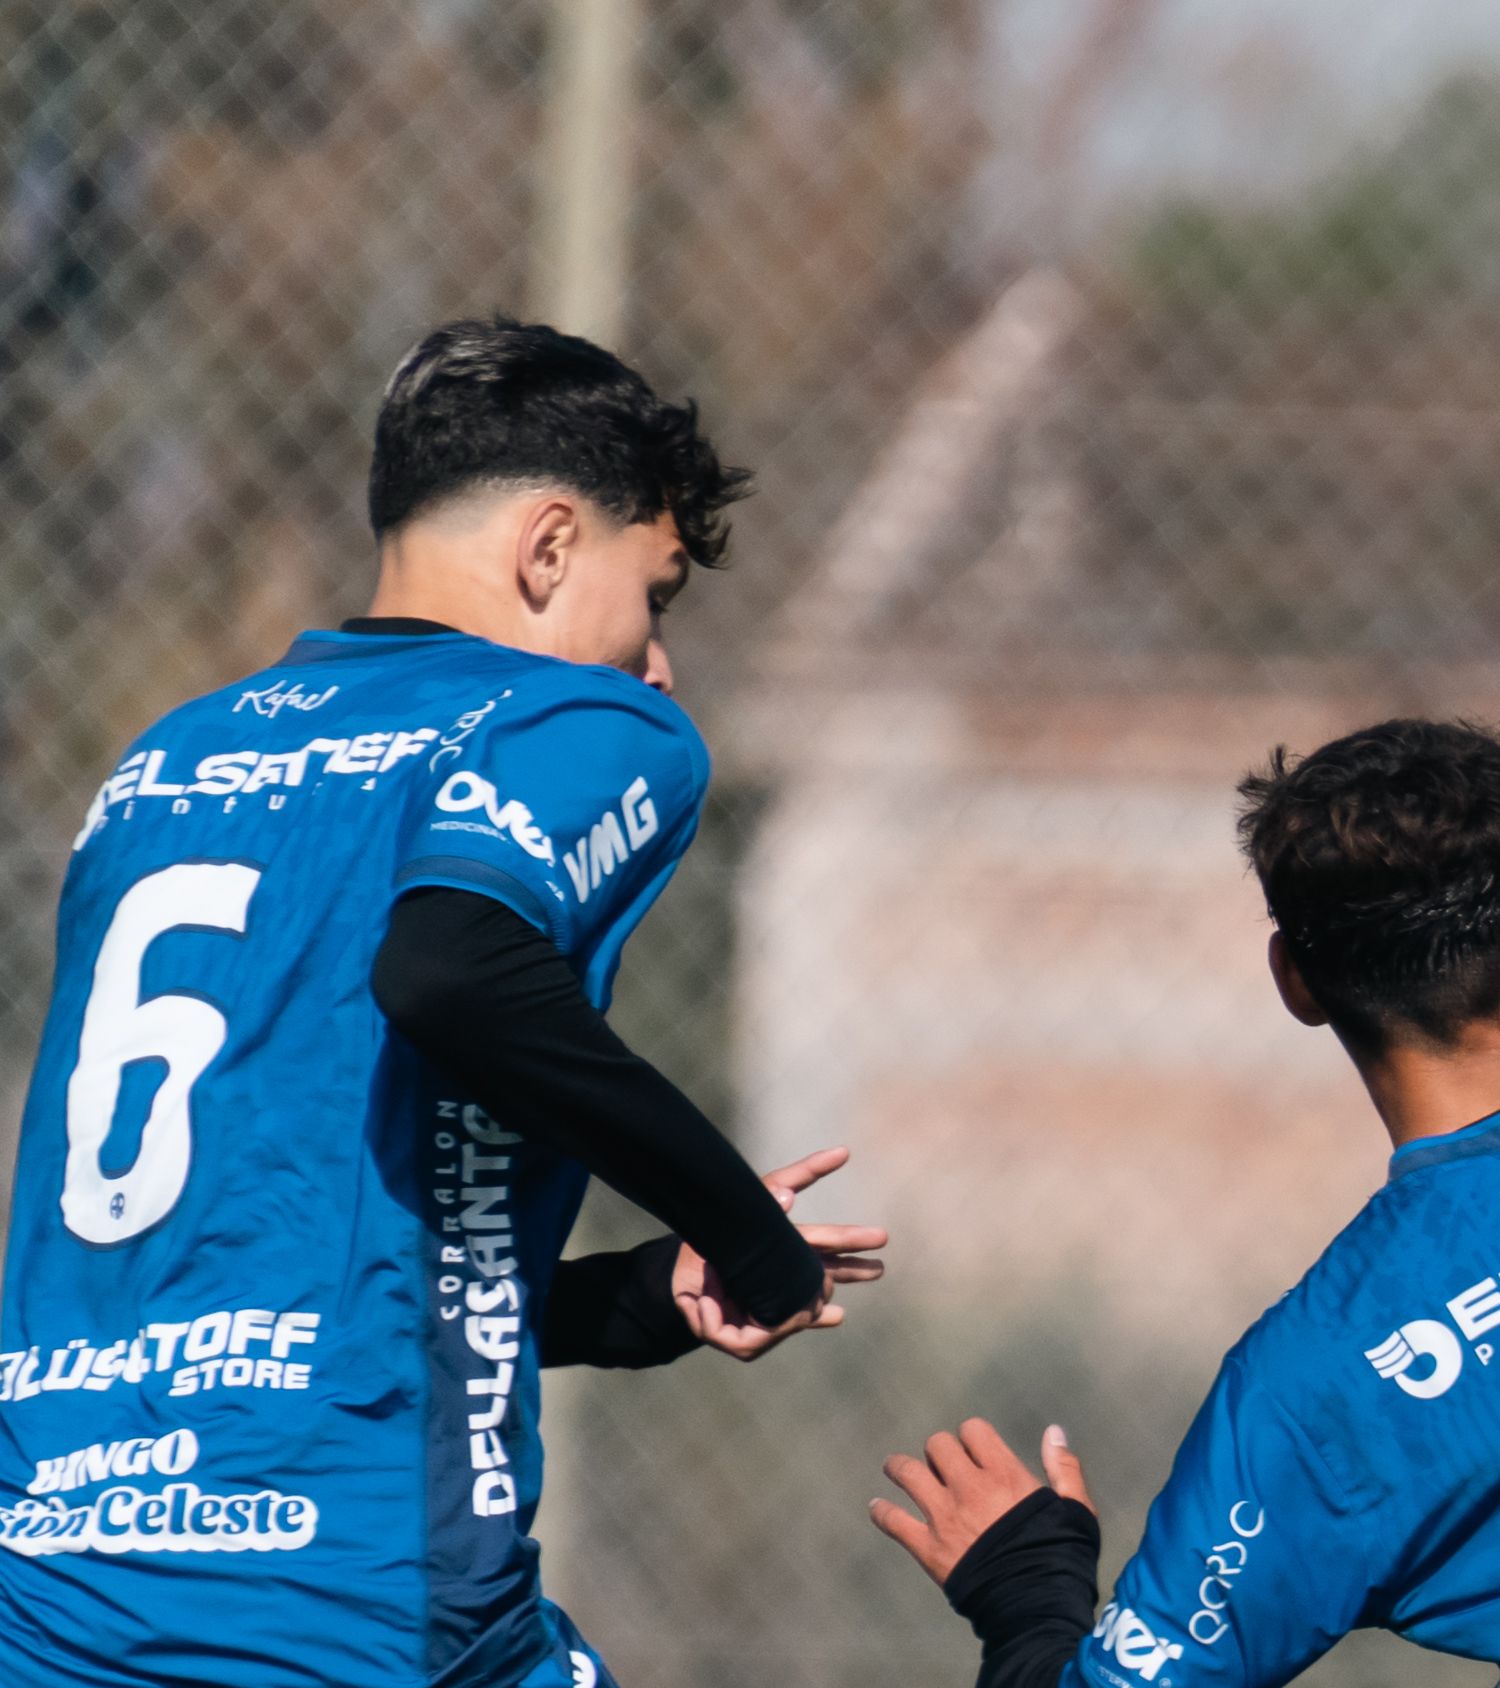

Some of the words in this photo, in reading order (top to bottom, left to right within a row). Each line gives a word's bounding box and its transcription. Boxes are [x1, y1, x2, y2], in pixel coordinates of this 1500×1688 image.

[563, 776, 659, 903] VMG
[60, 857, 266, 1244] 6
[168, 1358, 312, 1397] STORE
[26, 1428, 199, 1495] BINGO
[96, 1482, 319, 1553] Celeste
